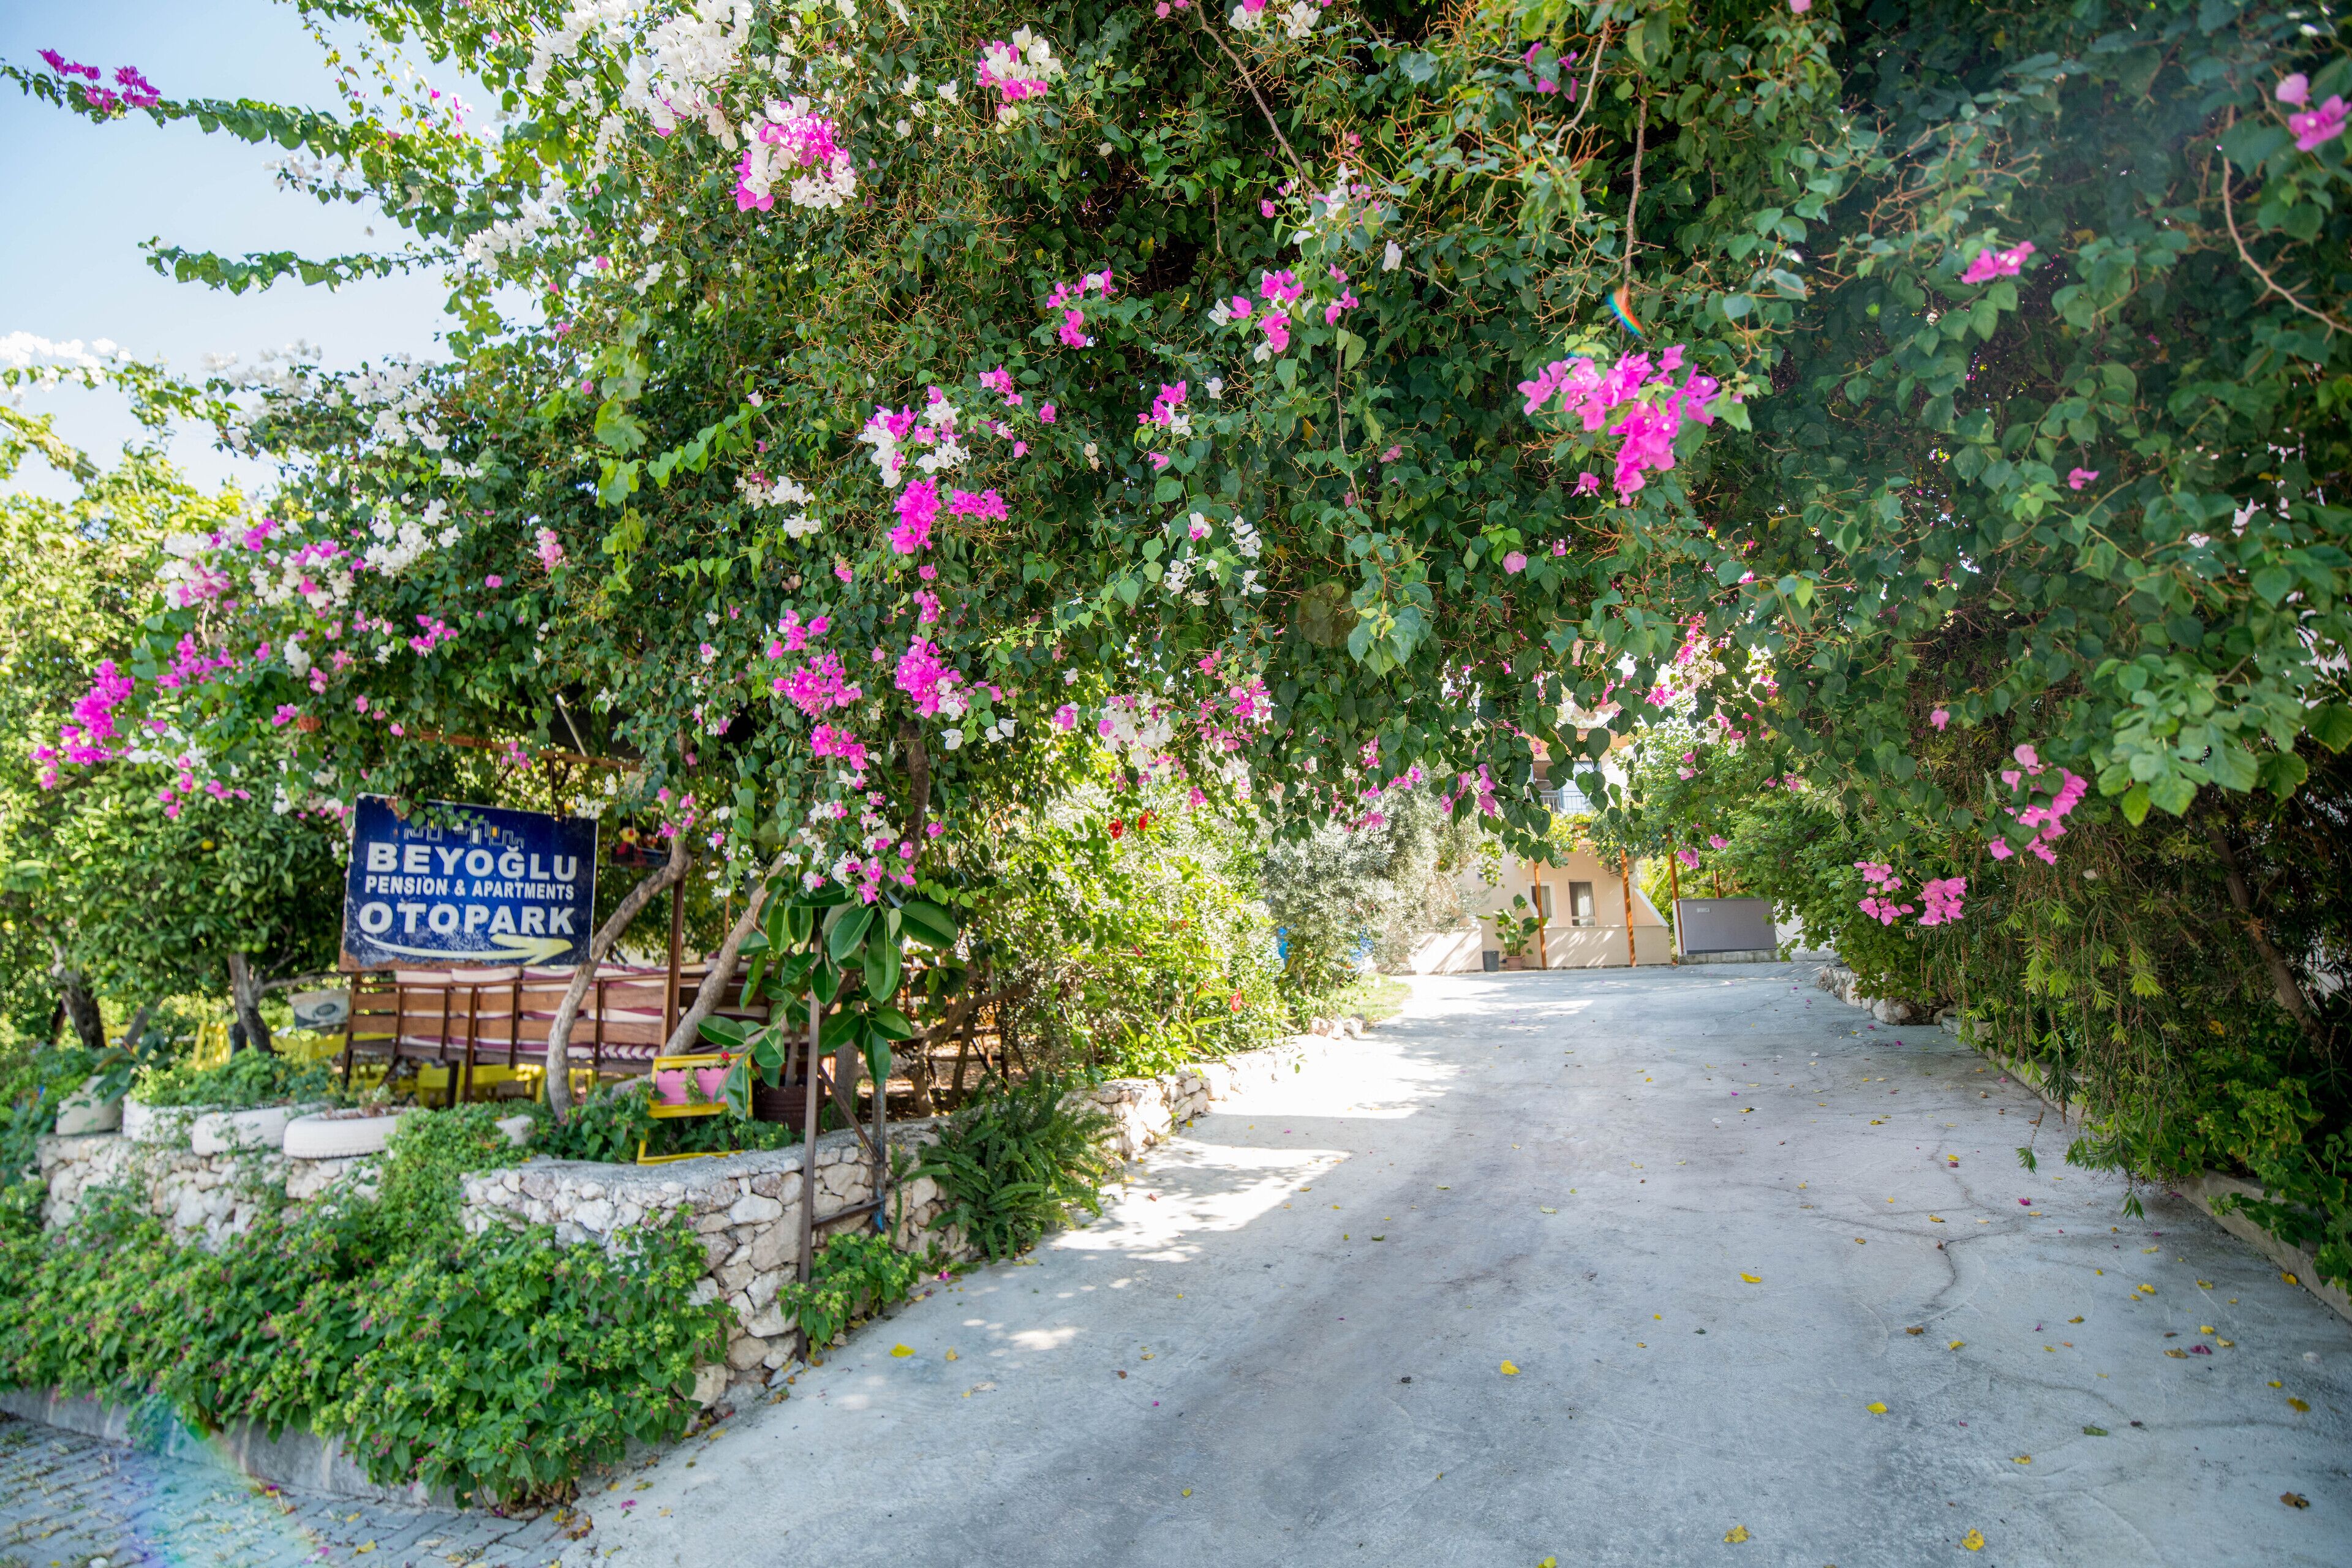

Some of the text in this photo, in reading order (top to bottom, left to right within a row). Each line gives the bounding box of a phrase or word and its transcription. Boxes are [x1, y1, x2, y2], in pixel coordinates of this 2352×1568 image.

[367, 842, 577, 881] BEYOĞLU
[365, 875, 575, 901] PENSION & APARTMENTS
[358, 902, 575, 935] OTOPARK
